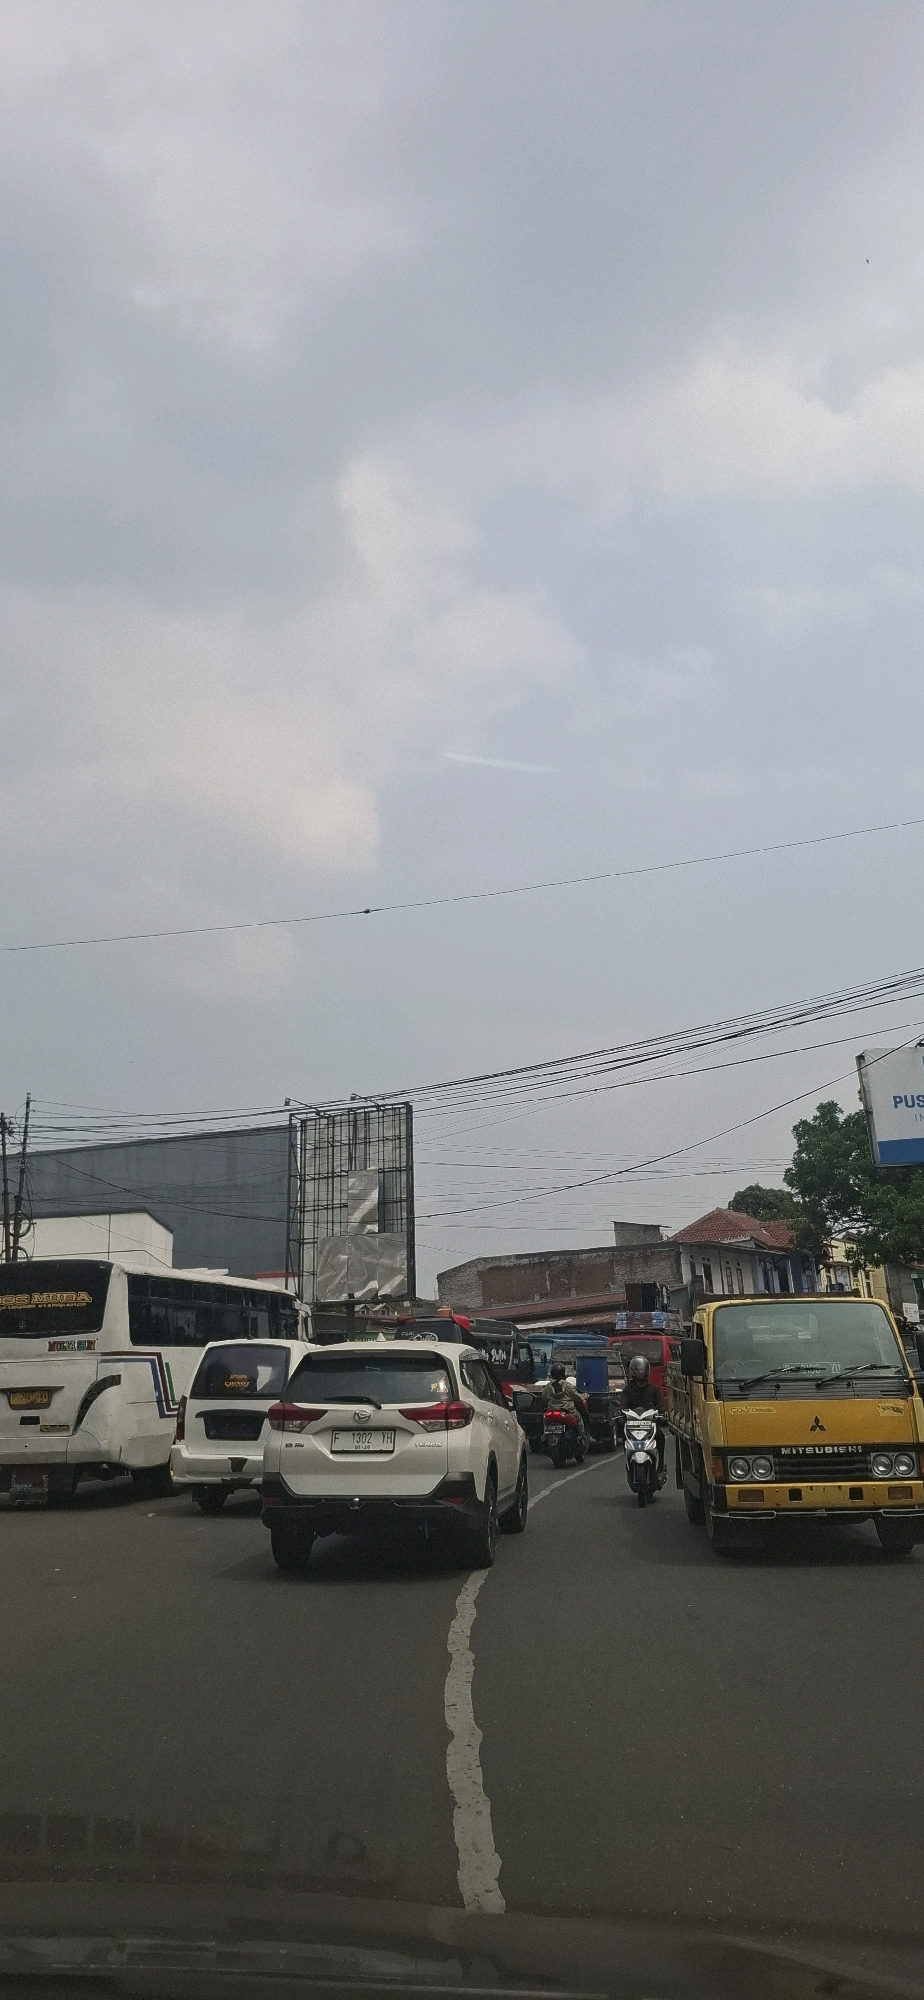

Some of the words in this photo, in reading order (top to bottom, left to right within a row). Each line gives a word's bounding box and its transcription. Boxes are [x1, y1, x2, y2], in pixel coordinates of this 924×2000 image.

[48, 1340, 76, 1352] MULYA
[334, 1433, 340, 1444] F
[351, 1432, 373, 1444] 1302
[382, 1431, 393, 1444] YH
[781, 1446, 862, 1455] MITSUBISHI
